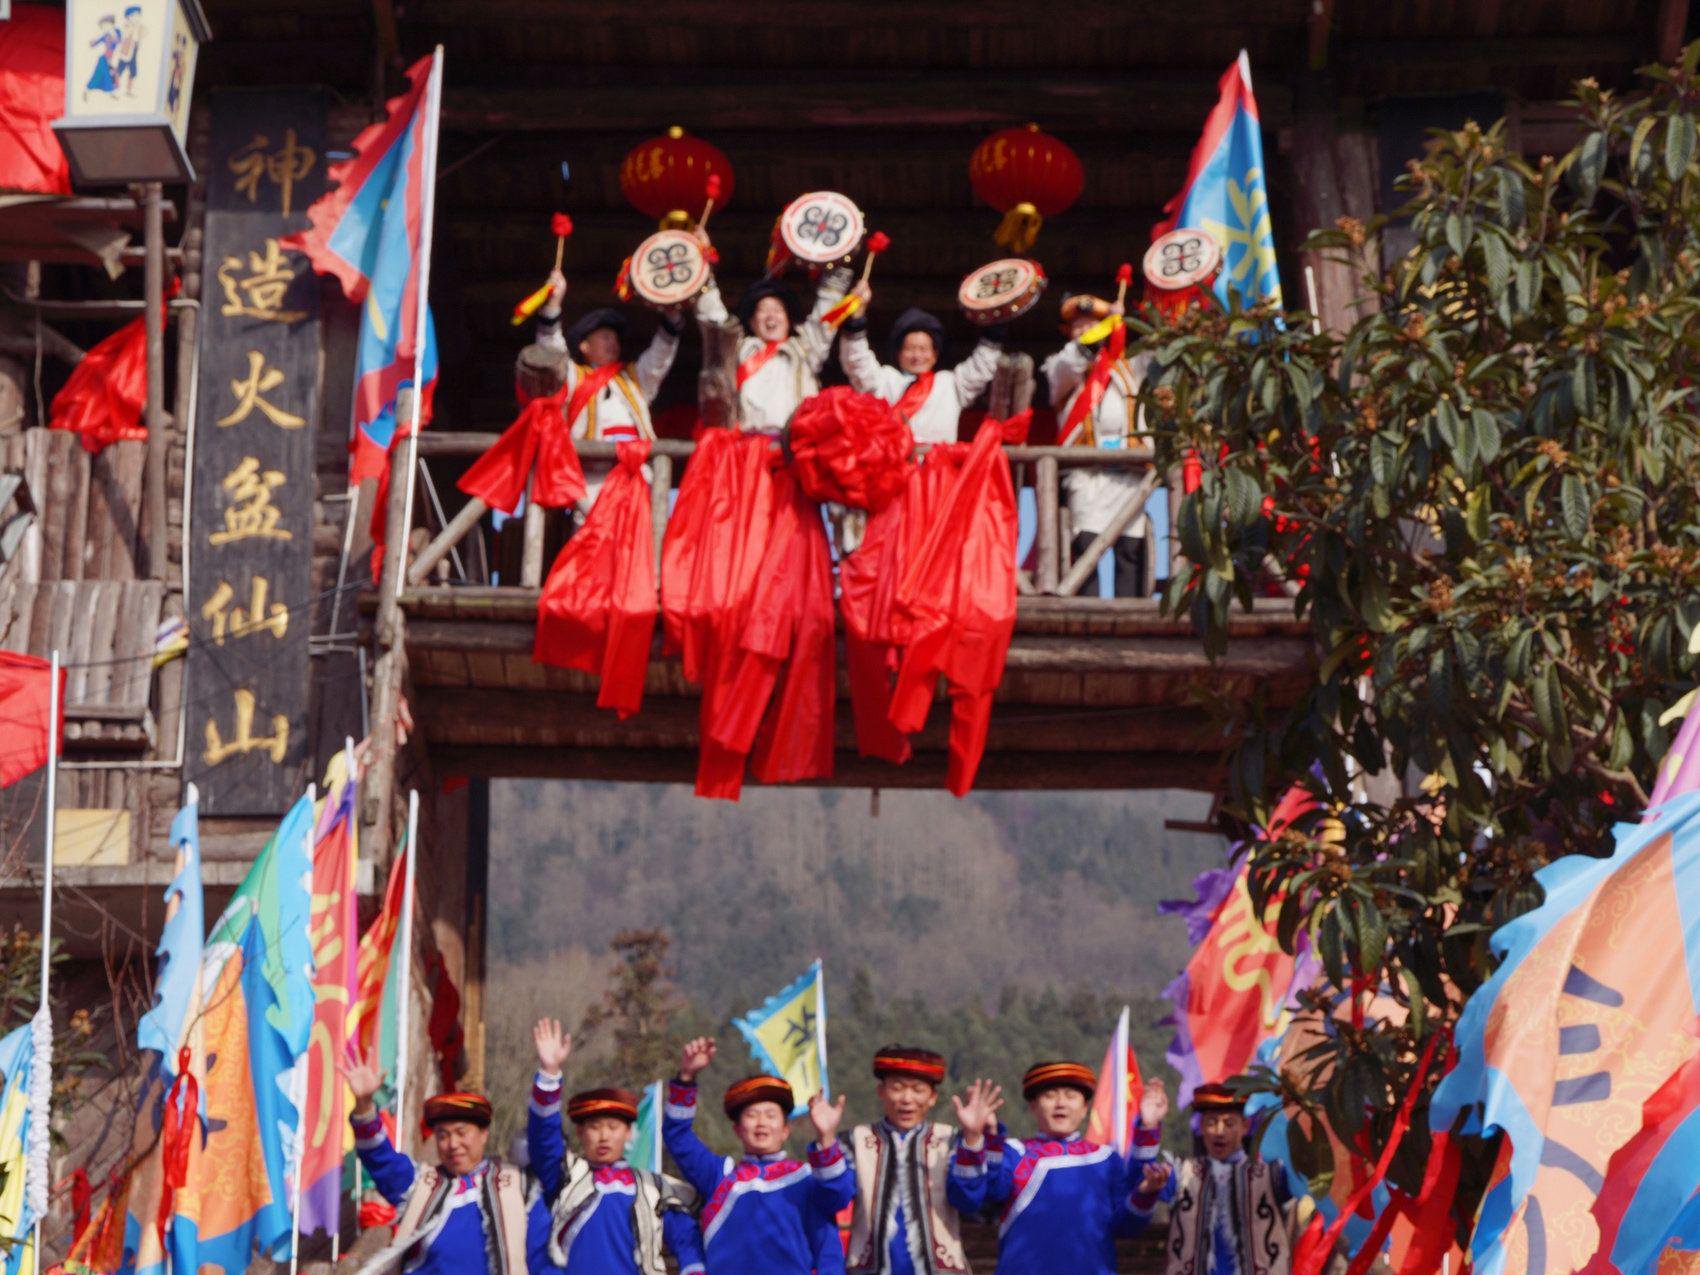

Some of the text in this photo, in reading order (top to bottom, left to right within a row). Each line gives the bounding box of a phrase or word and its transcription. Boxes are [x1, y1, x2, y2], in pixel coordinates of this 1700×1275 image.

[201, 128, 317, 766] 神造火盆仙山
